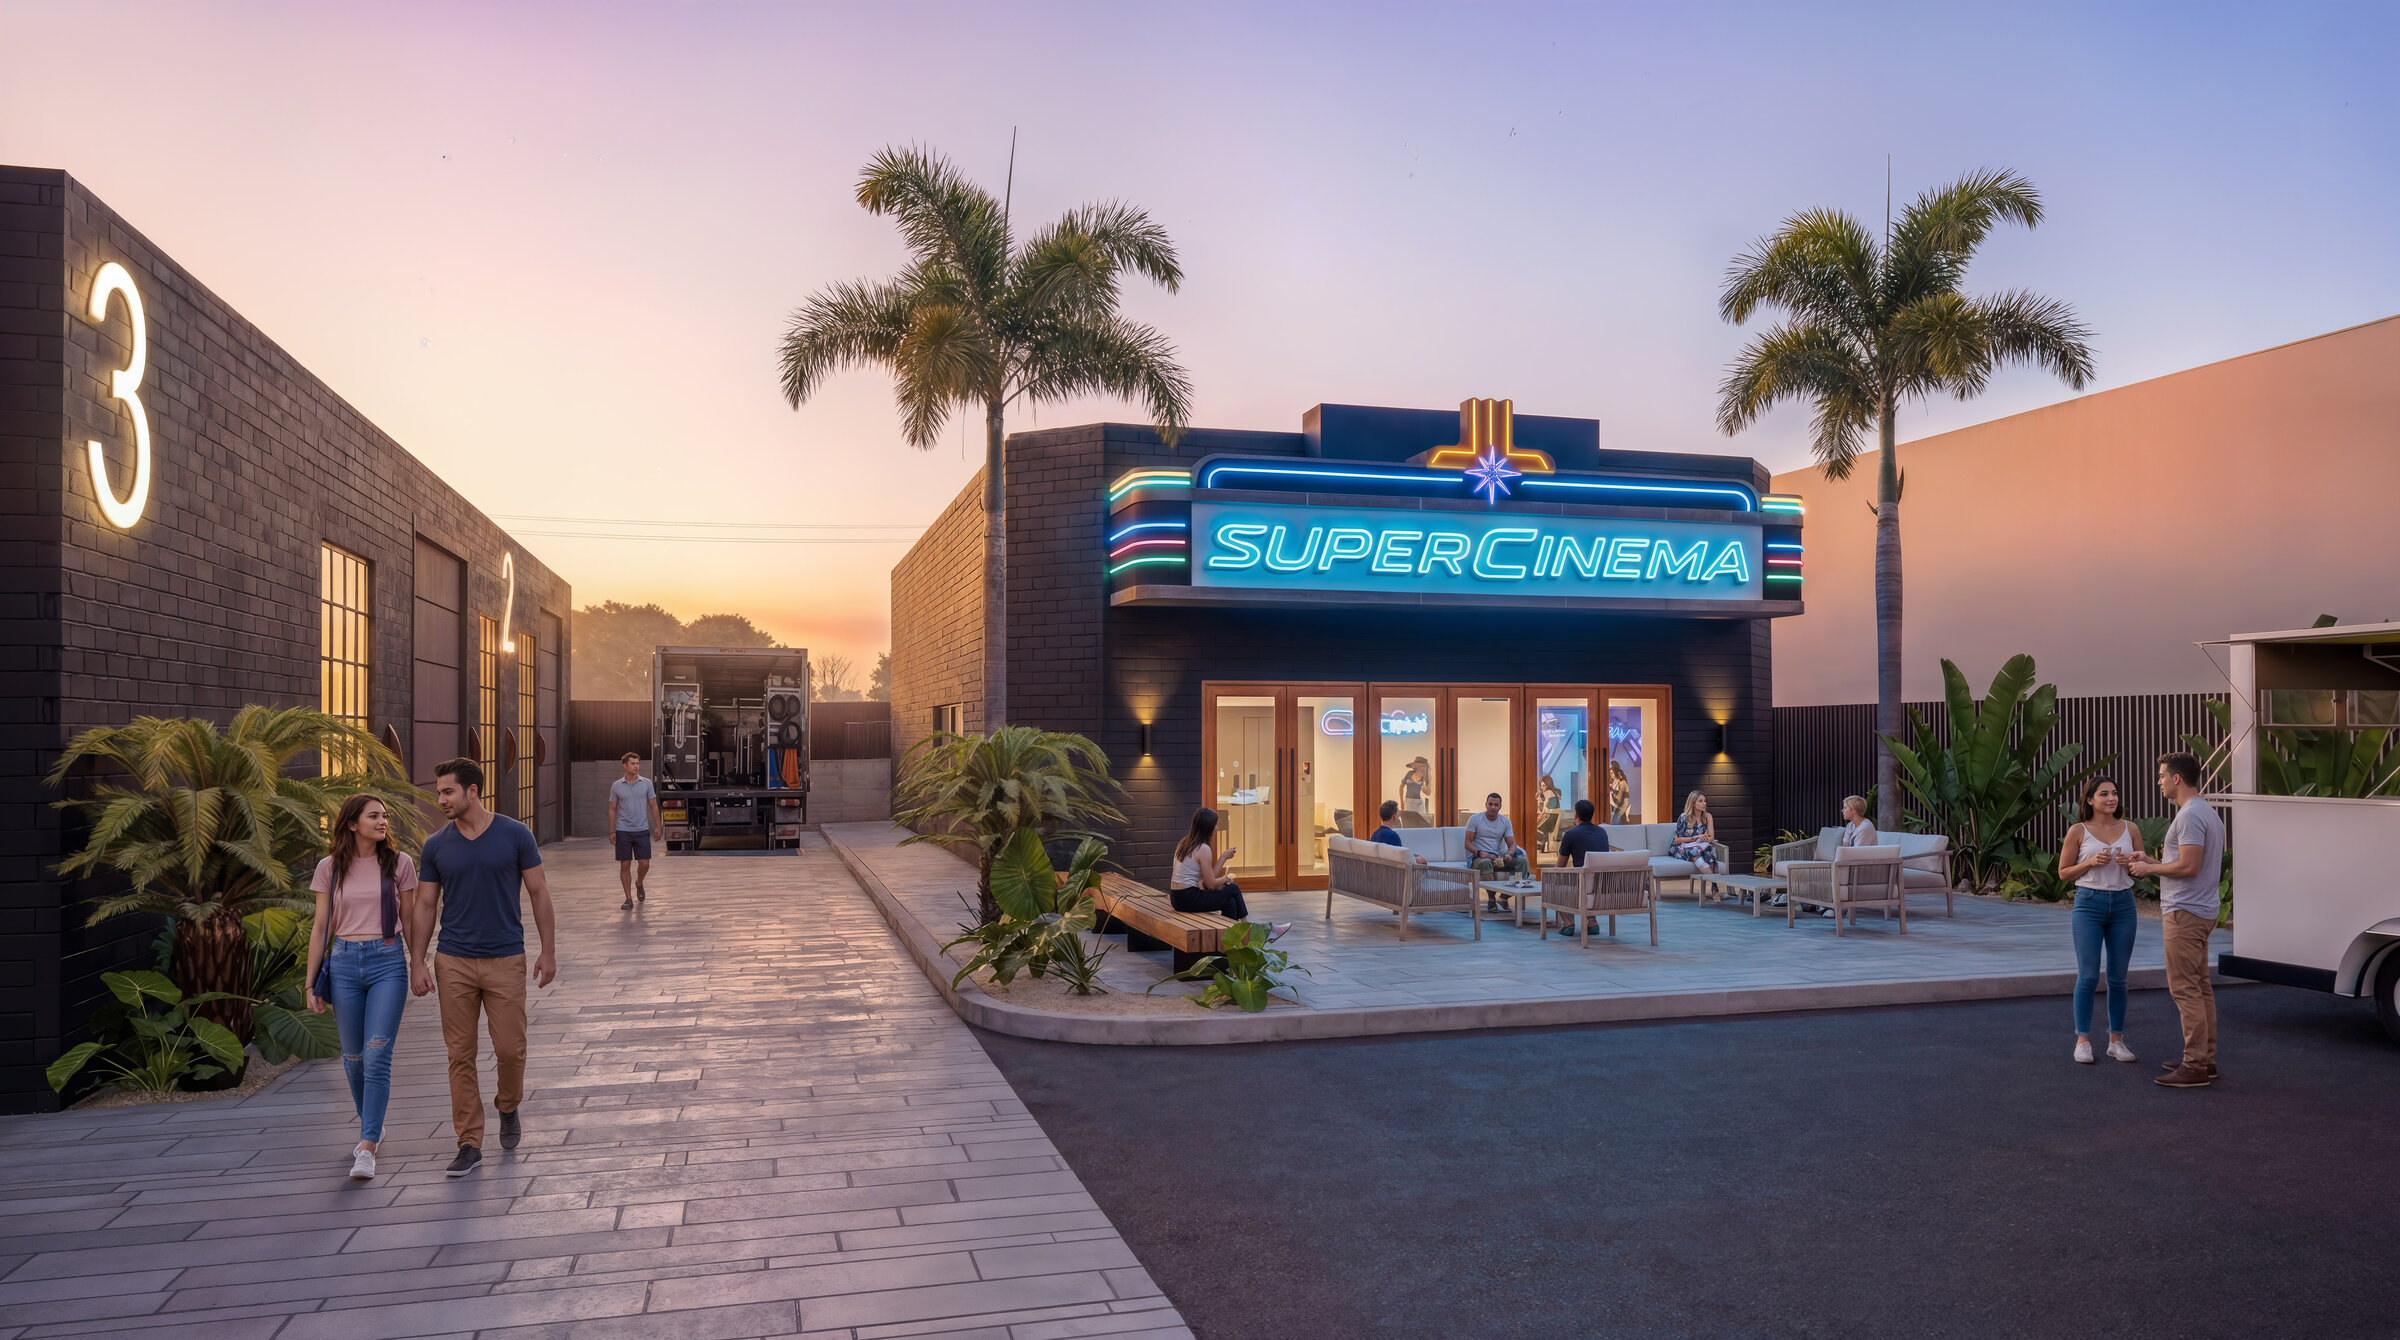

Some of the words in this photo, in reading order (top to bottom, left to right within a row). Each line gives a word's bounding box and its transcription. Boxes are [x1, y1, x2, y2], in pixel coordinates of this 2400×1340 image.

[88, 262, 151, 529] 3
[502, 552, 515, 652] 2
[1208, 523, 1751, 584] SUPERCINEMA
